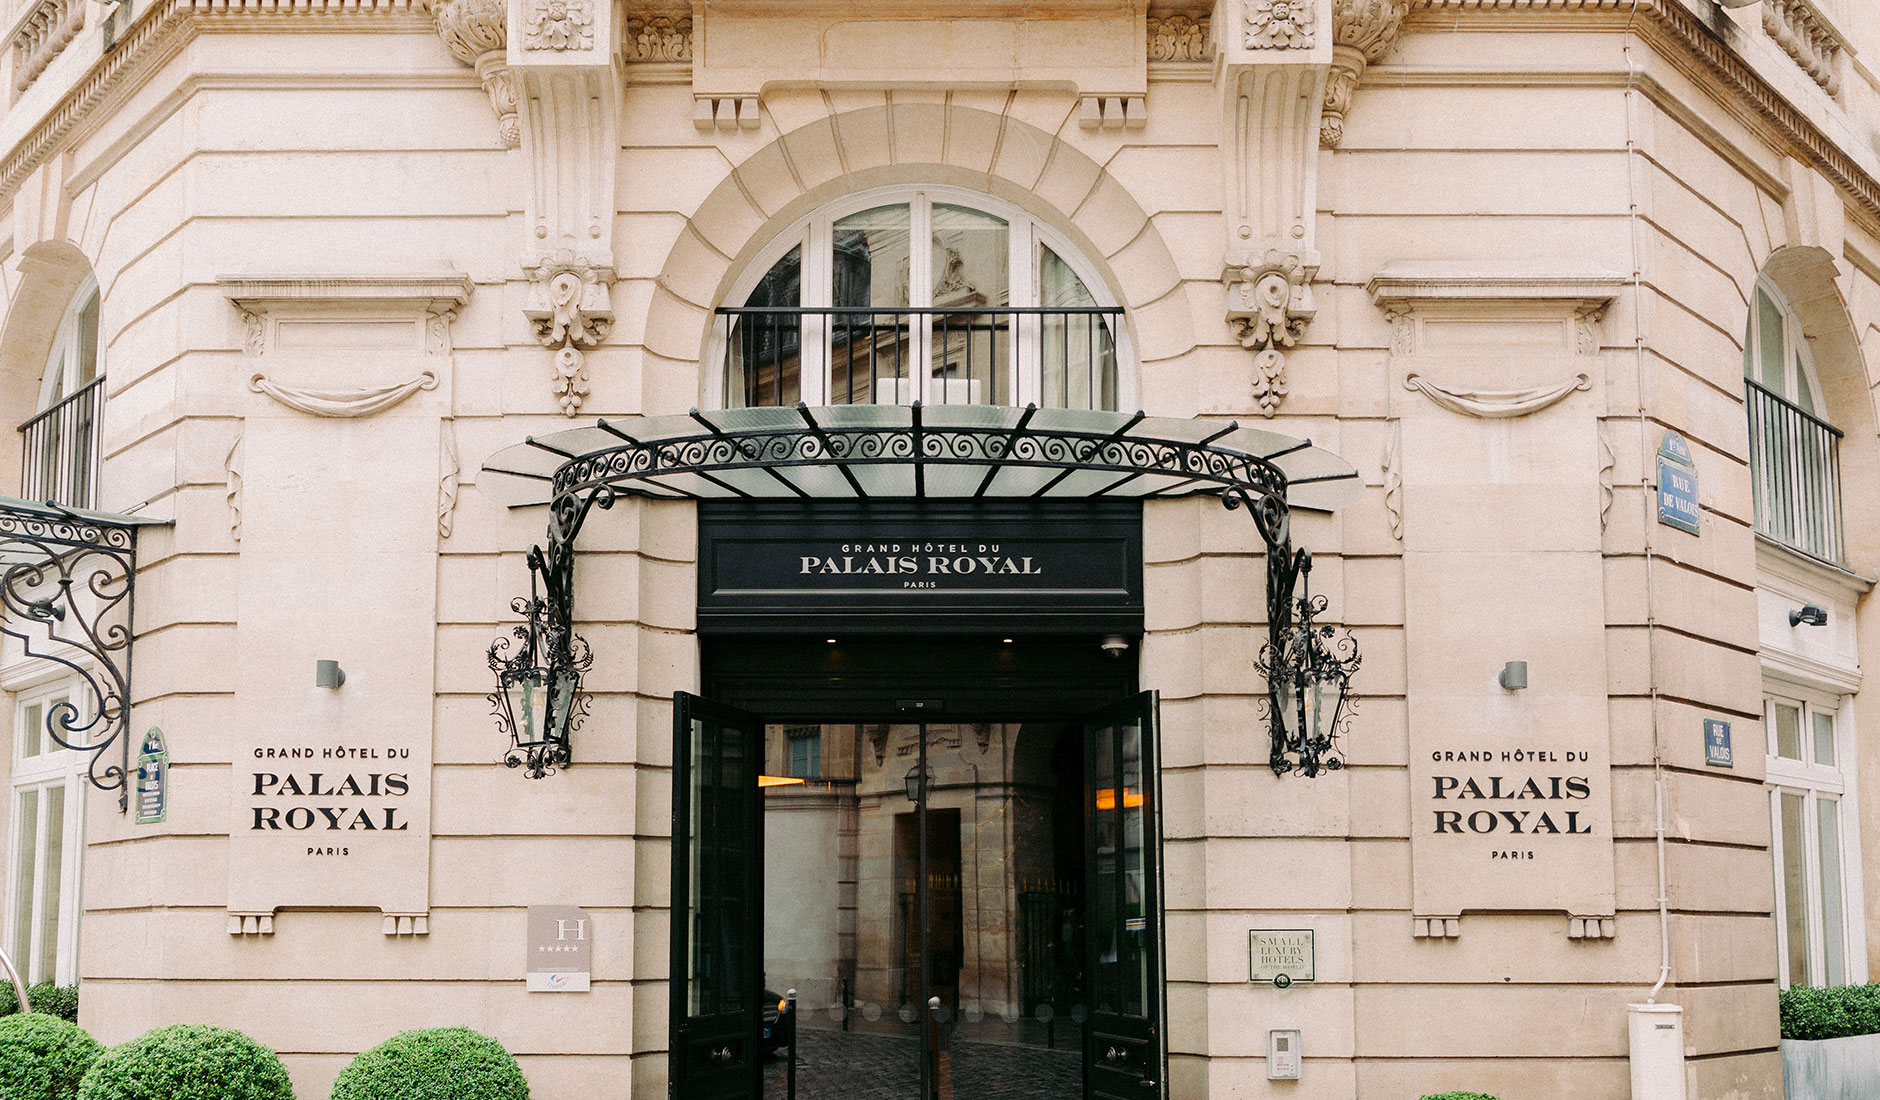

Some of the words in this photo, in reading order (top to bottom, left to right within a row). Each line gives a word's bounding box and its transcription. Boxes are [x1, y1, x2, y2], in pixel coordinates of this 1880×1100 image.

[1672, 474, 1690, 493] RUE
[1663, 492, 1673, 508] DE
[1675, 496, 1698, 518] VALOIS
[841, 544, 901, 553] GRAND
[912, 542, 968, 553] HÔTEL
[978, 544, 1000, 553] DU
[799, 556, 919, 574] PALAIS
[927, 556, 1042, 575] ROYAL
[1712, 723, 1724, 737] RUE
[1715, 737, 1722, 745] DE
[254, 748, 314, 758] GRAND
[323, 745, 379, 758] HÔTEL
[387, 748, 409, 758] DU
[1432, 751, 1493, 762] GRAND
[1501, 748, 1557, 762] HÔTEL
[1566, 751, 1588, 762] DU
[1709, 745, 1730, 760] VALOIS
[251, 773, 409, 796] PALAIS
[1432, 776, 1590, 800] PALAIS
[251, 807, 408, 830] ROYAL
[1433, 810, 1591, 834] ROYAL
[307, 847, 349, 856] PARIS
[1491, 851, 1534, 860] PARIS
[553, 918, 588, 941] H
[1260, 937, 1304, 946] SMALL
[1260, 947, 1302, 955] LUXURY
[1261, 956, 1304, 964] HOTELS
